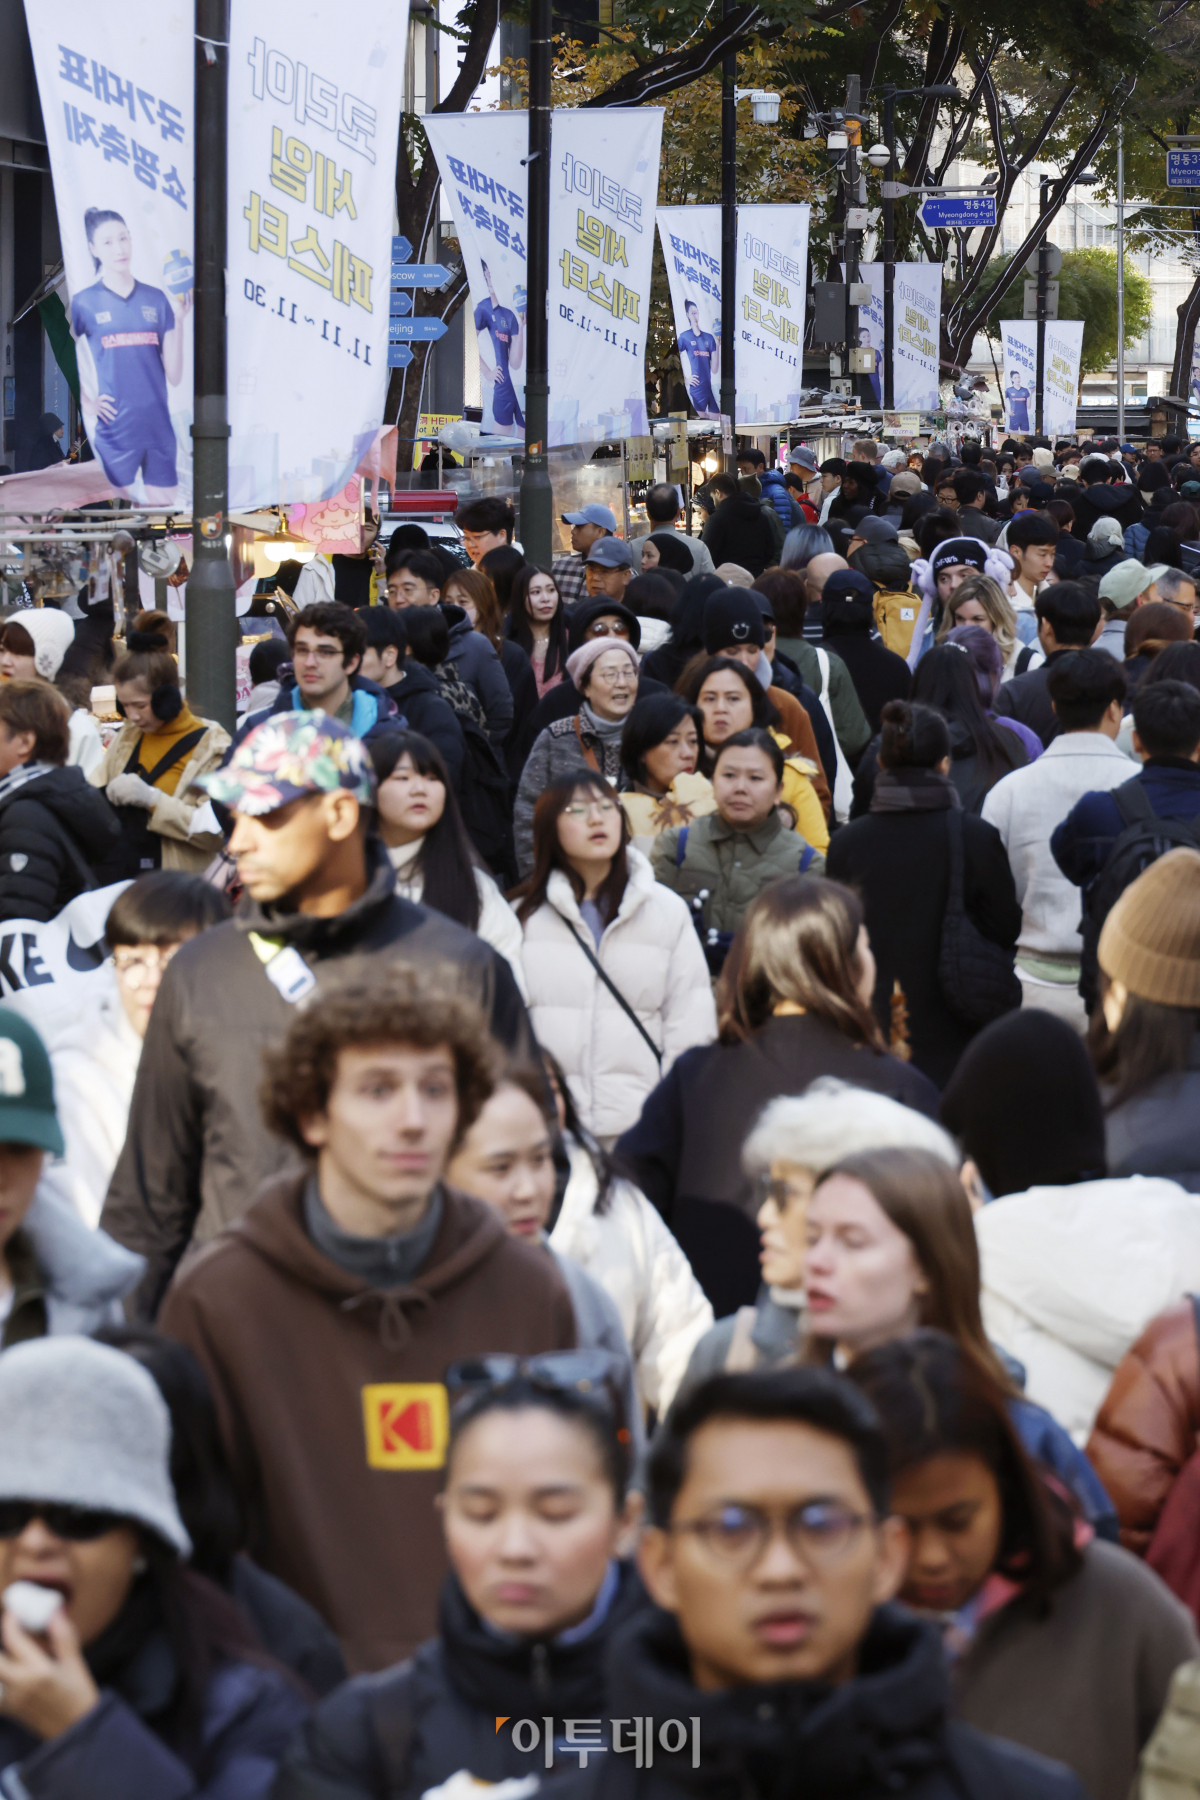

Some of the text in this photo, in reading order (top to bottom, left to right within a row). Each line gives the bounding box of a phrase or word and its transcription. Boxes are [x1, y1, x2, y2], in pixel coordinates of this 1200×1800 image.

[1171, 154, 1200, 166] 명동3
[964, 200, 994, 210] 명동4길
[939, 210, 994, 219] Myeongdong 4-gil
[391, 272, 416, 280] scow
[389, 323, 414, 334] eijing
